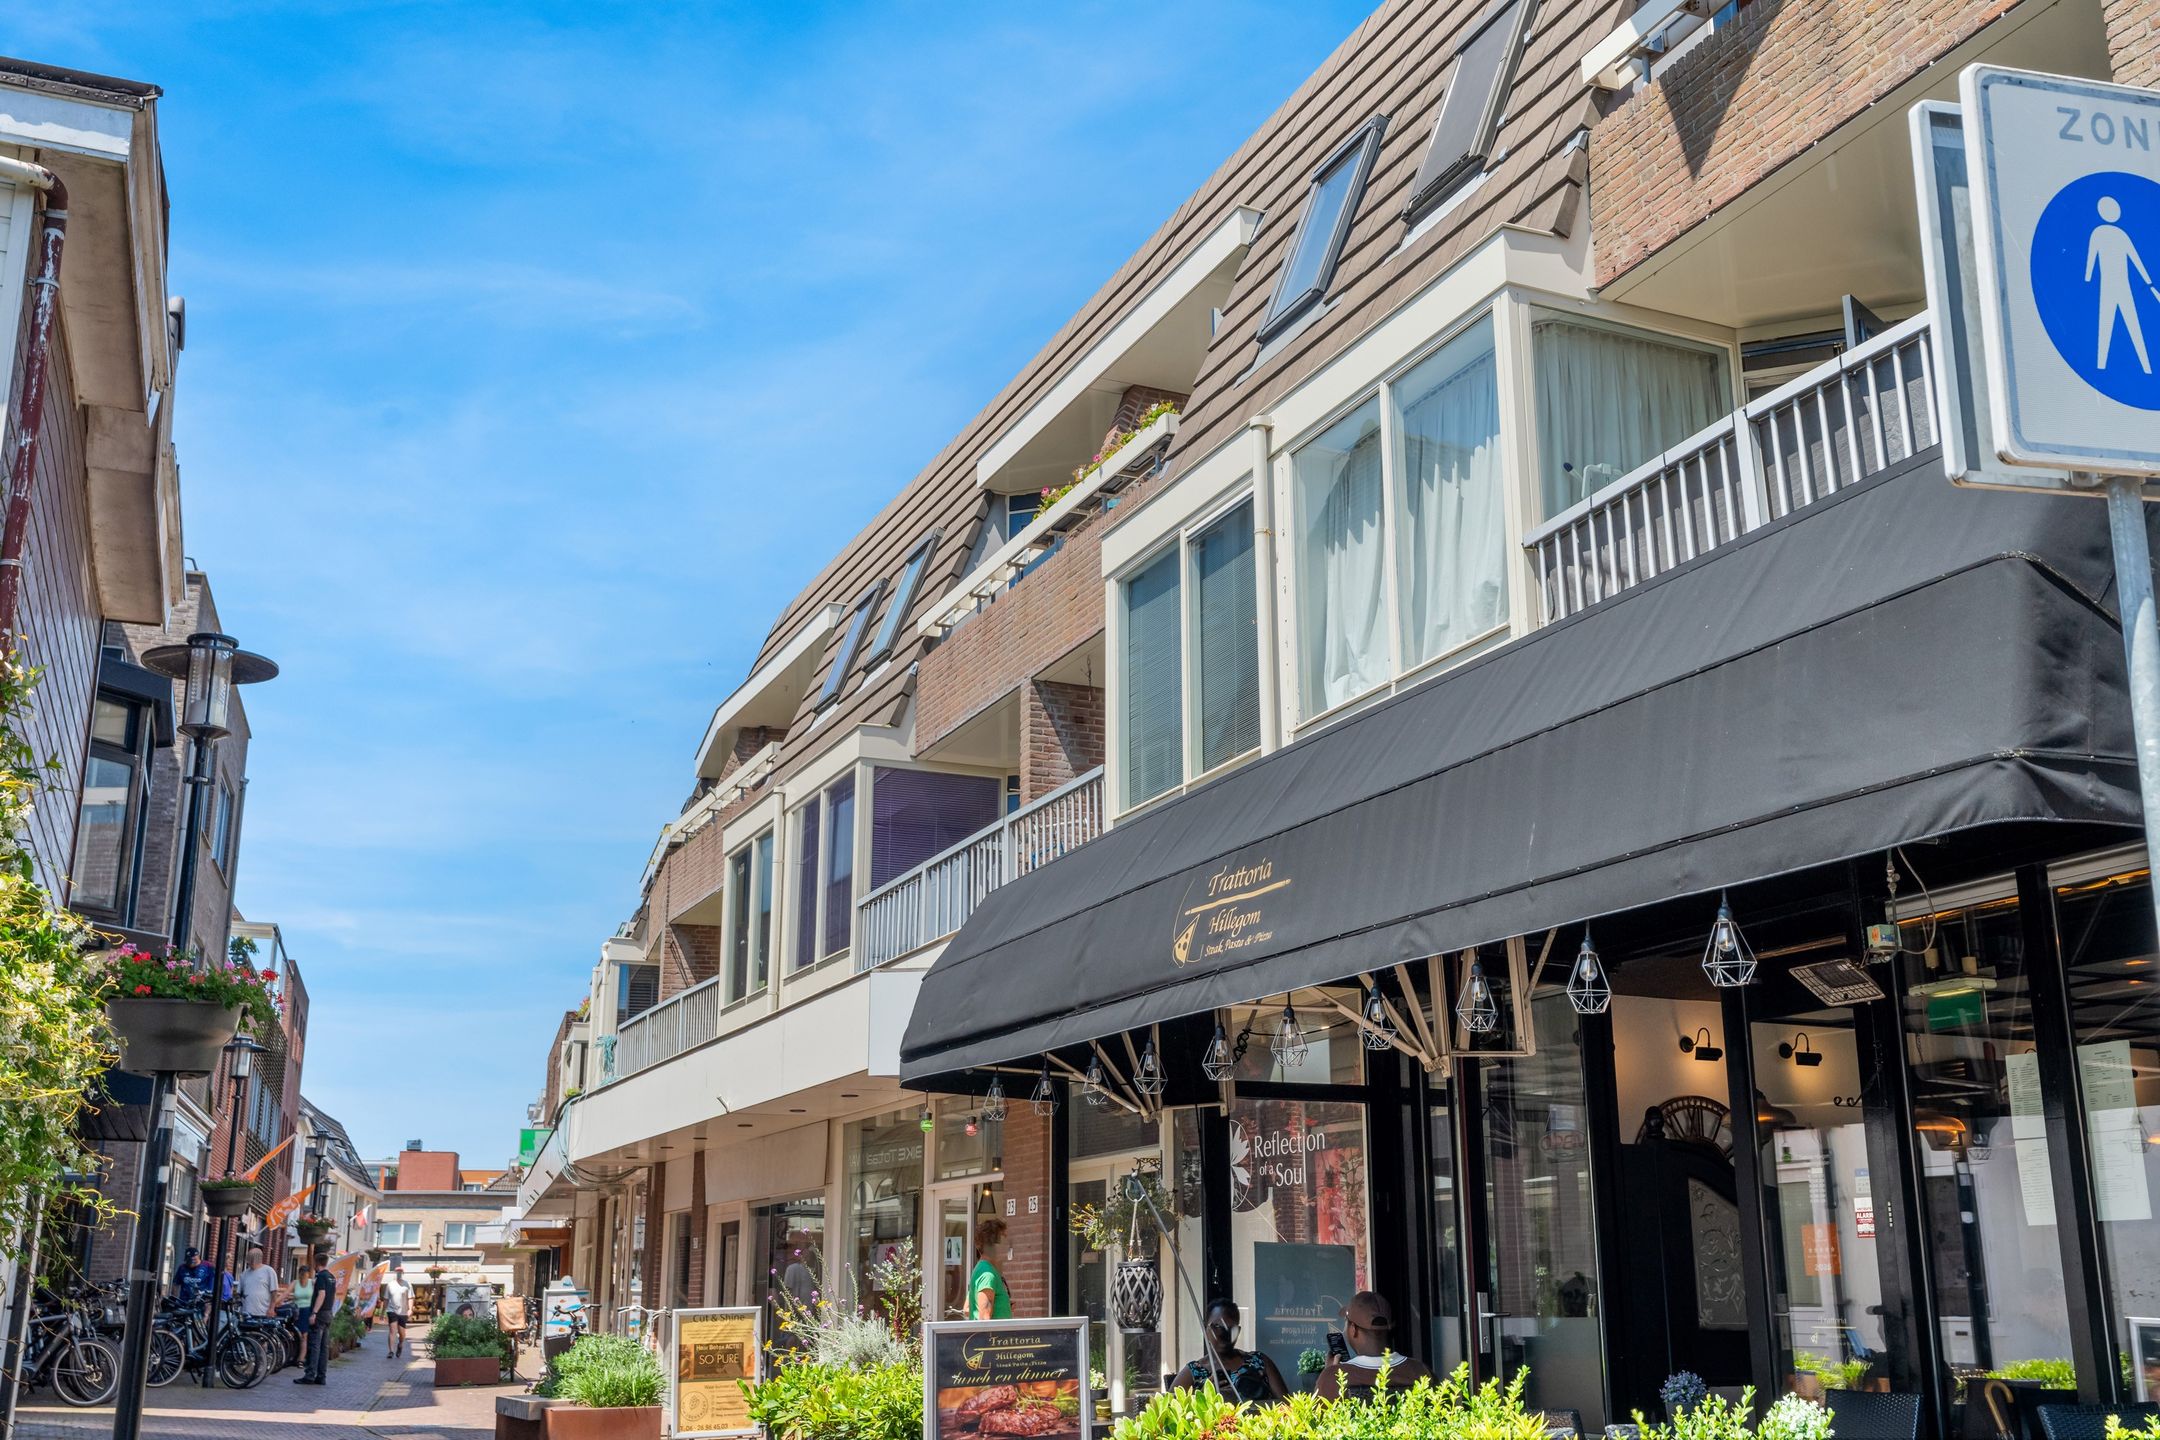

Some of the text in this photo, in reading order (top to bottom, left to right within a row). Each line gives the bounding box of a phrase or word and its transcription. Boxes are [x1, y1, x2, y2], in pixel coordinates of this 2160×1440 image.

[2056, 106, 2160, 151] ZON
[1208, 857, 1272, 897] Trattoria
[1208, 906, 1261, 938] Hillegom
[1254, 1128, 1326, 1158] Reflection
[1260, 1161, 1307, 1187] of a Soul
[692, 1313, 745, 1323] Cut & Shine
[989, 1335, 1041, 1347] Trattoria
[698, 1353, 739, 1365] SO PURE
[995, 1351, 1034, 1361] Hillegom
[995, 1373, 1011, 1382] en
